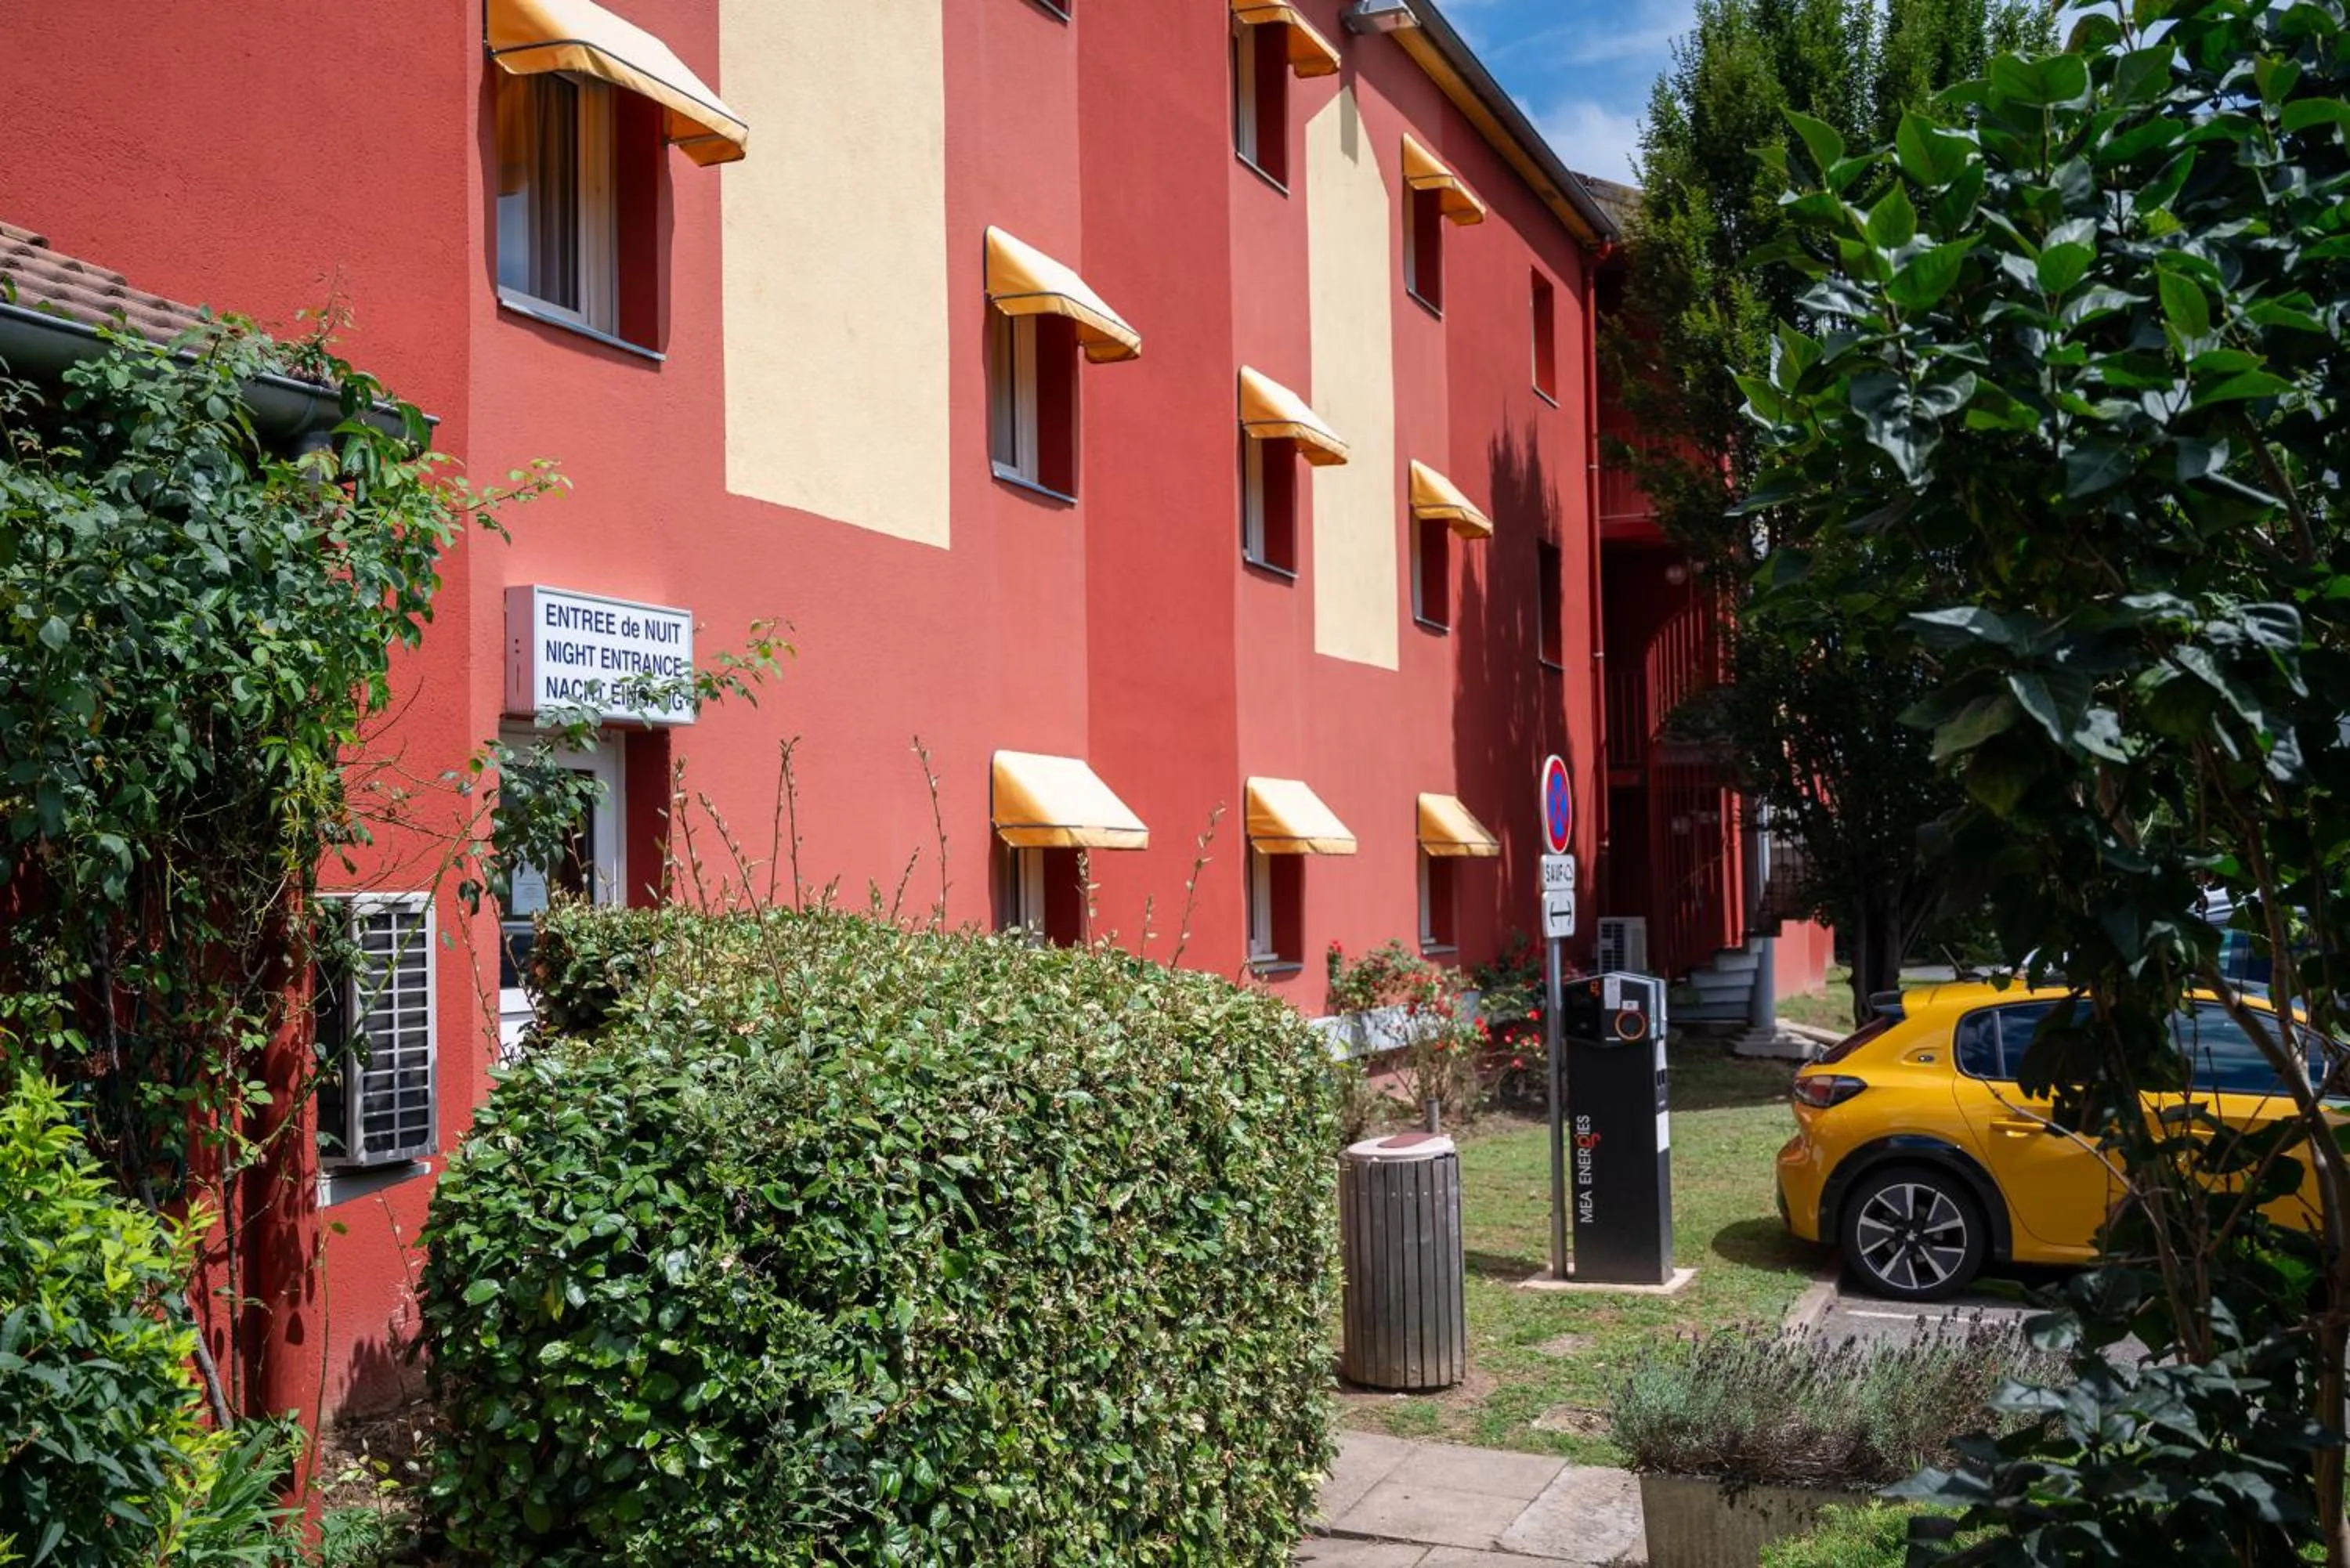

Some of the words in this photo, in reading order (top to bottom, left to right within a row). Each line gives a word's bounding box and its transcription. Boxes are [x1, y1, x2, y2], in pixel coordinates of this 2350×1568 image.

[545, 602, 616, 635] ENTREE
[621, 616, 640, 638] de
[645, 618, 682, 645] NUIT
[545, 638, 596, 667] NIGHT
[600, 646, 682, 677] ENTRANCE
[1579, 1190, 1593, 1223] MEA
